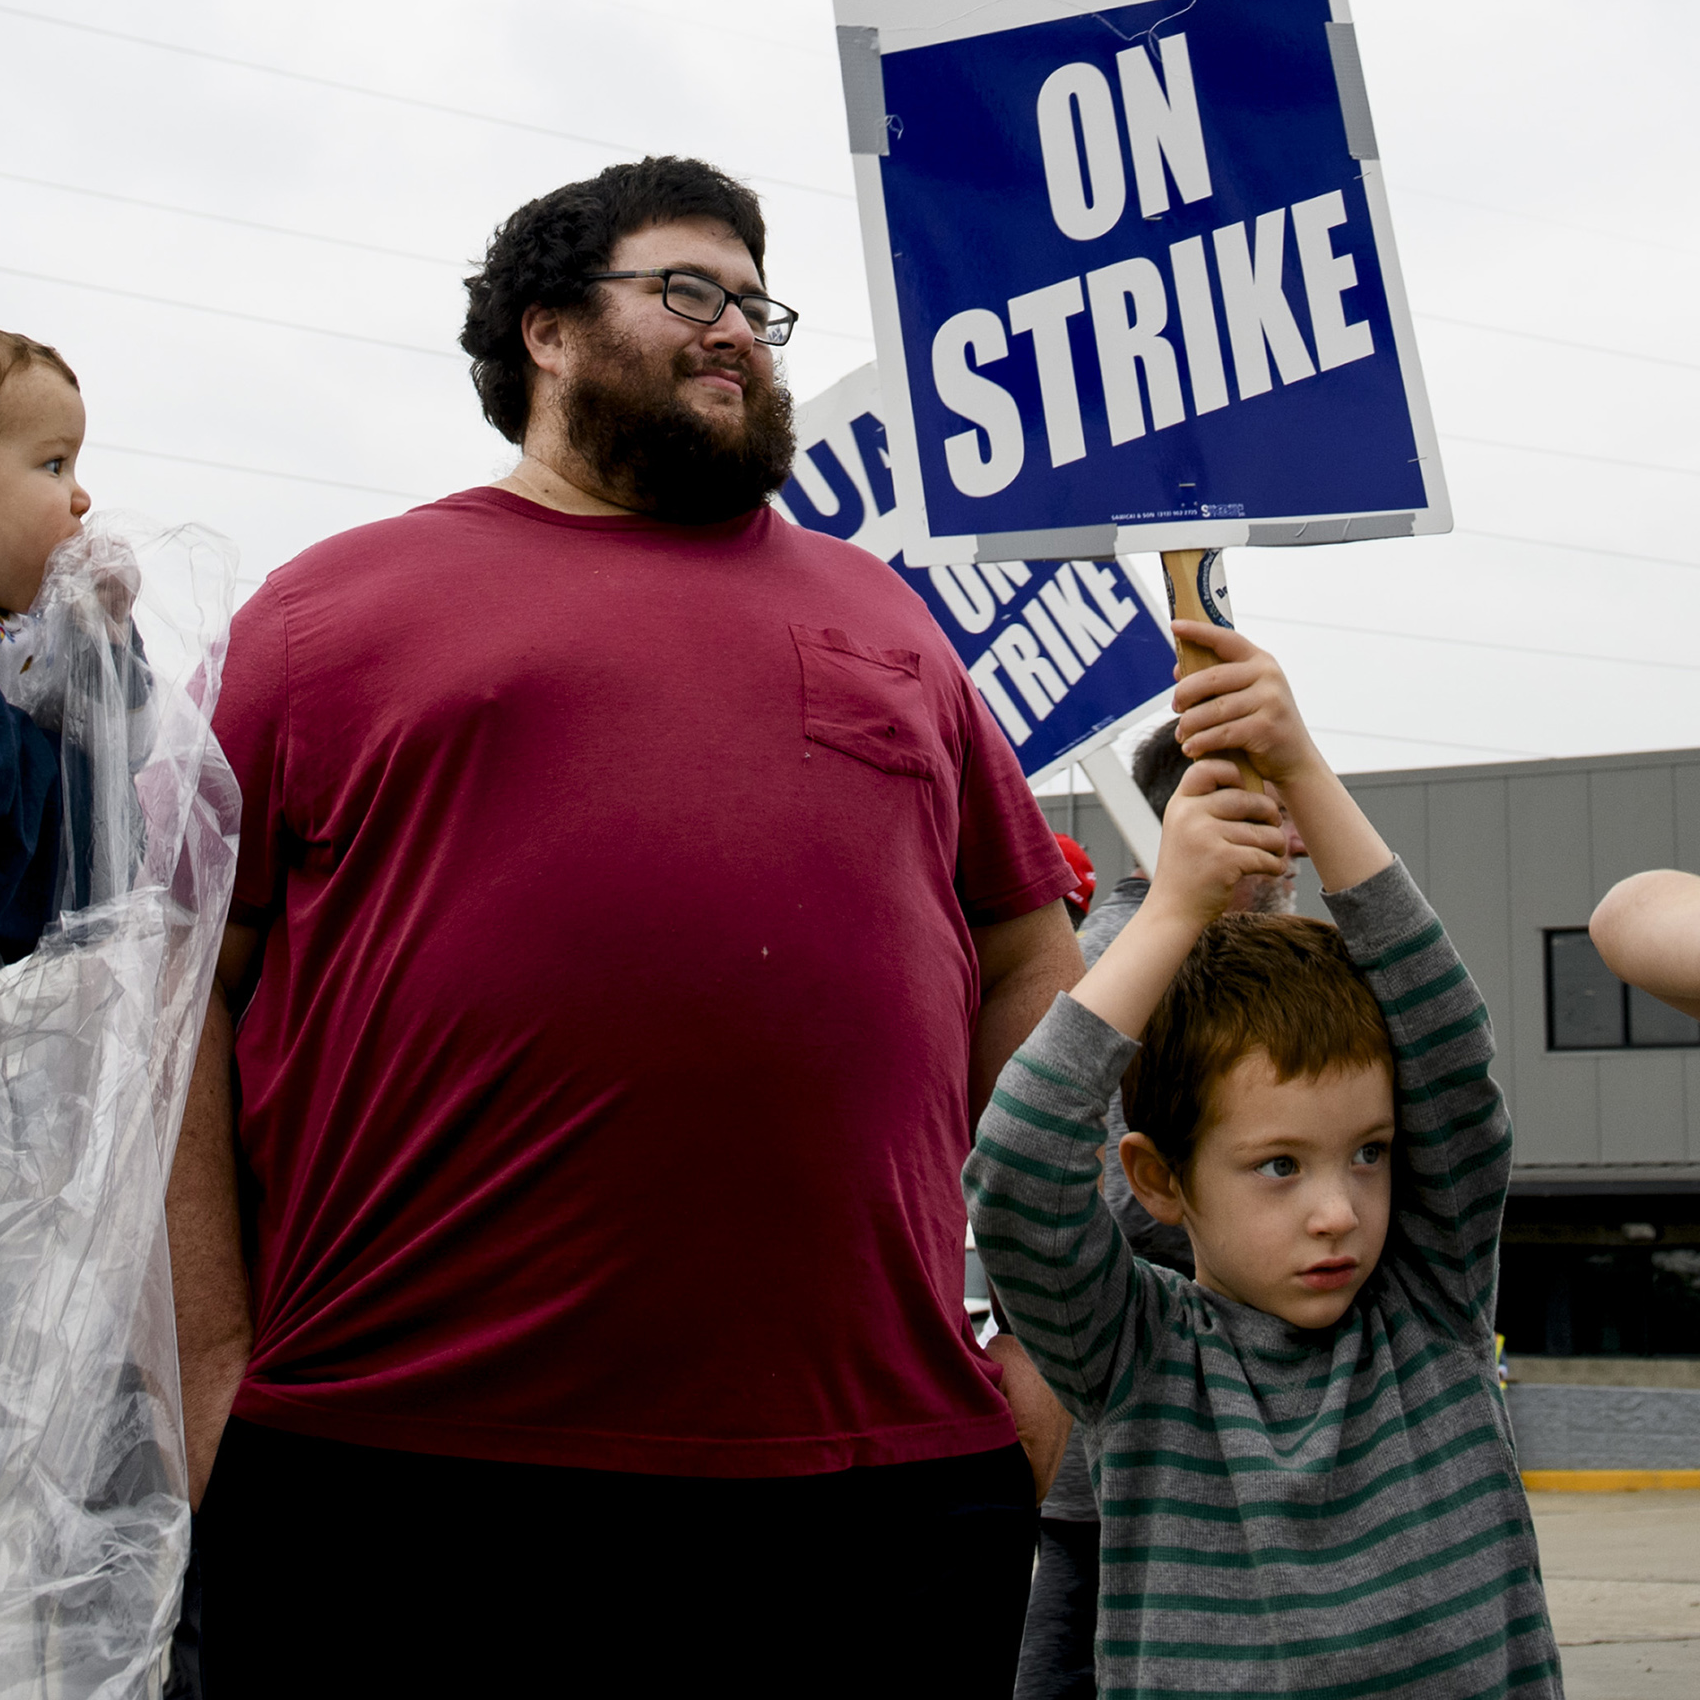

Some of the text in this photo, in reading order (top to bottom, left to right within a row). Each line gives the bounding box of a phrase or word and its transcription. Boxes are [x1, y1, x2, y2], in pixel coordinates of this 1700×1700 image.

[1036, 31, 1213, 242] ON
[931, 188, 1375, 499] STRIKE
[780, 411, 897, 541] UA
[967, 560, 1139, 747] TRIKE
